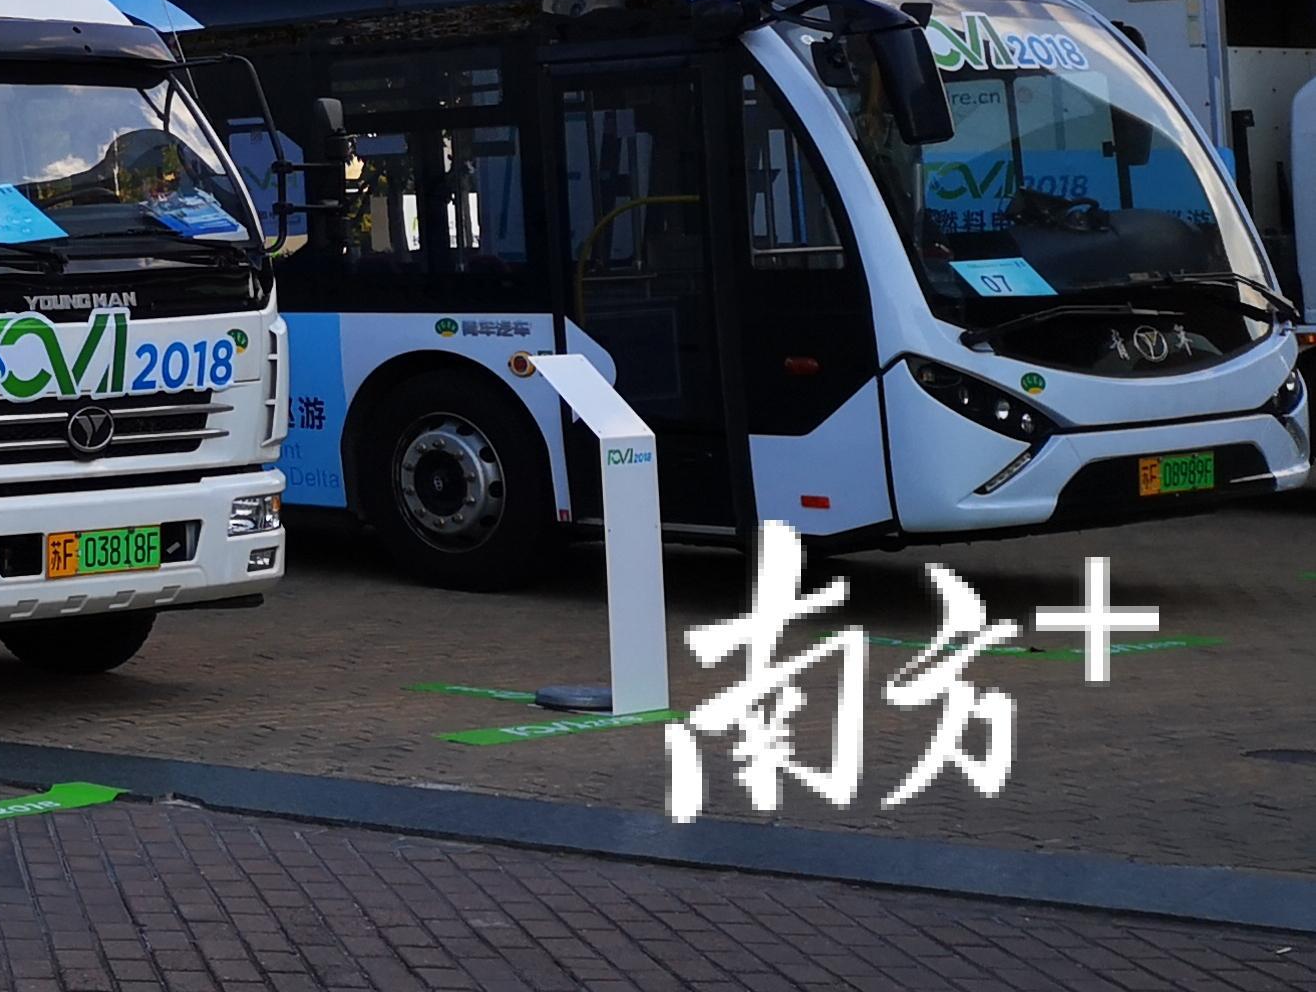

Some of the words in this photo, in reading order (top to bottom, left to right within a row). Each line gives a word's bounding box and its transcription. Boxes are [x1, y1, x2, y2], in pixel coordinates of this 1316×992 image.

[1007, 34, 1085, 67] 2018
[131, 339, 235, 391] 2018
[290, 467, 340, 489] Delta
